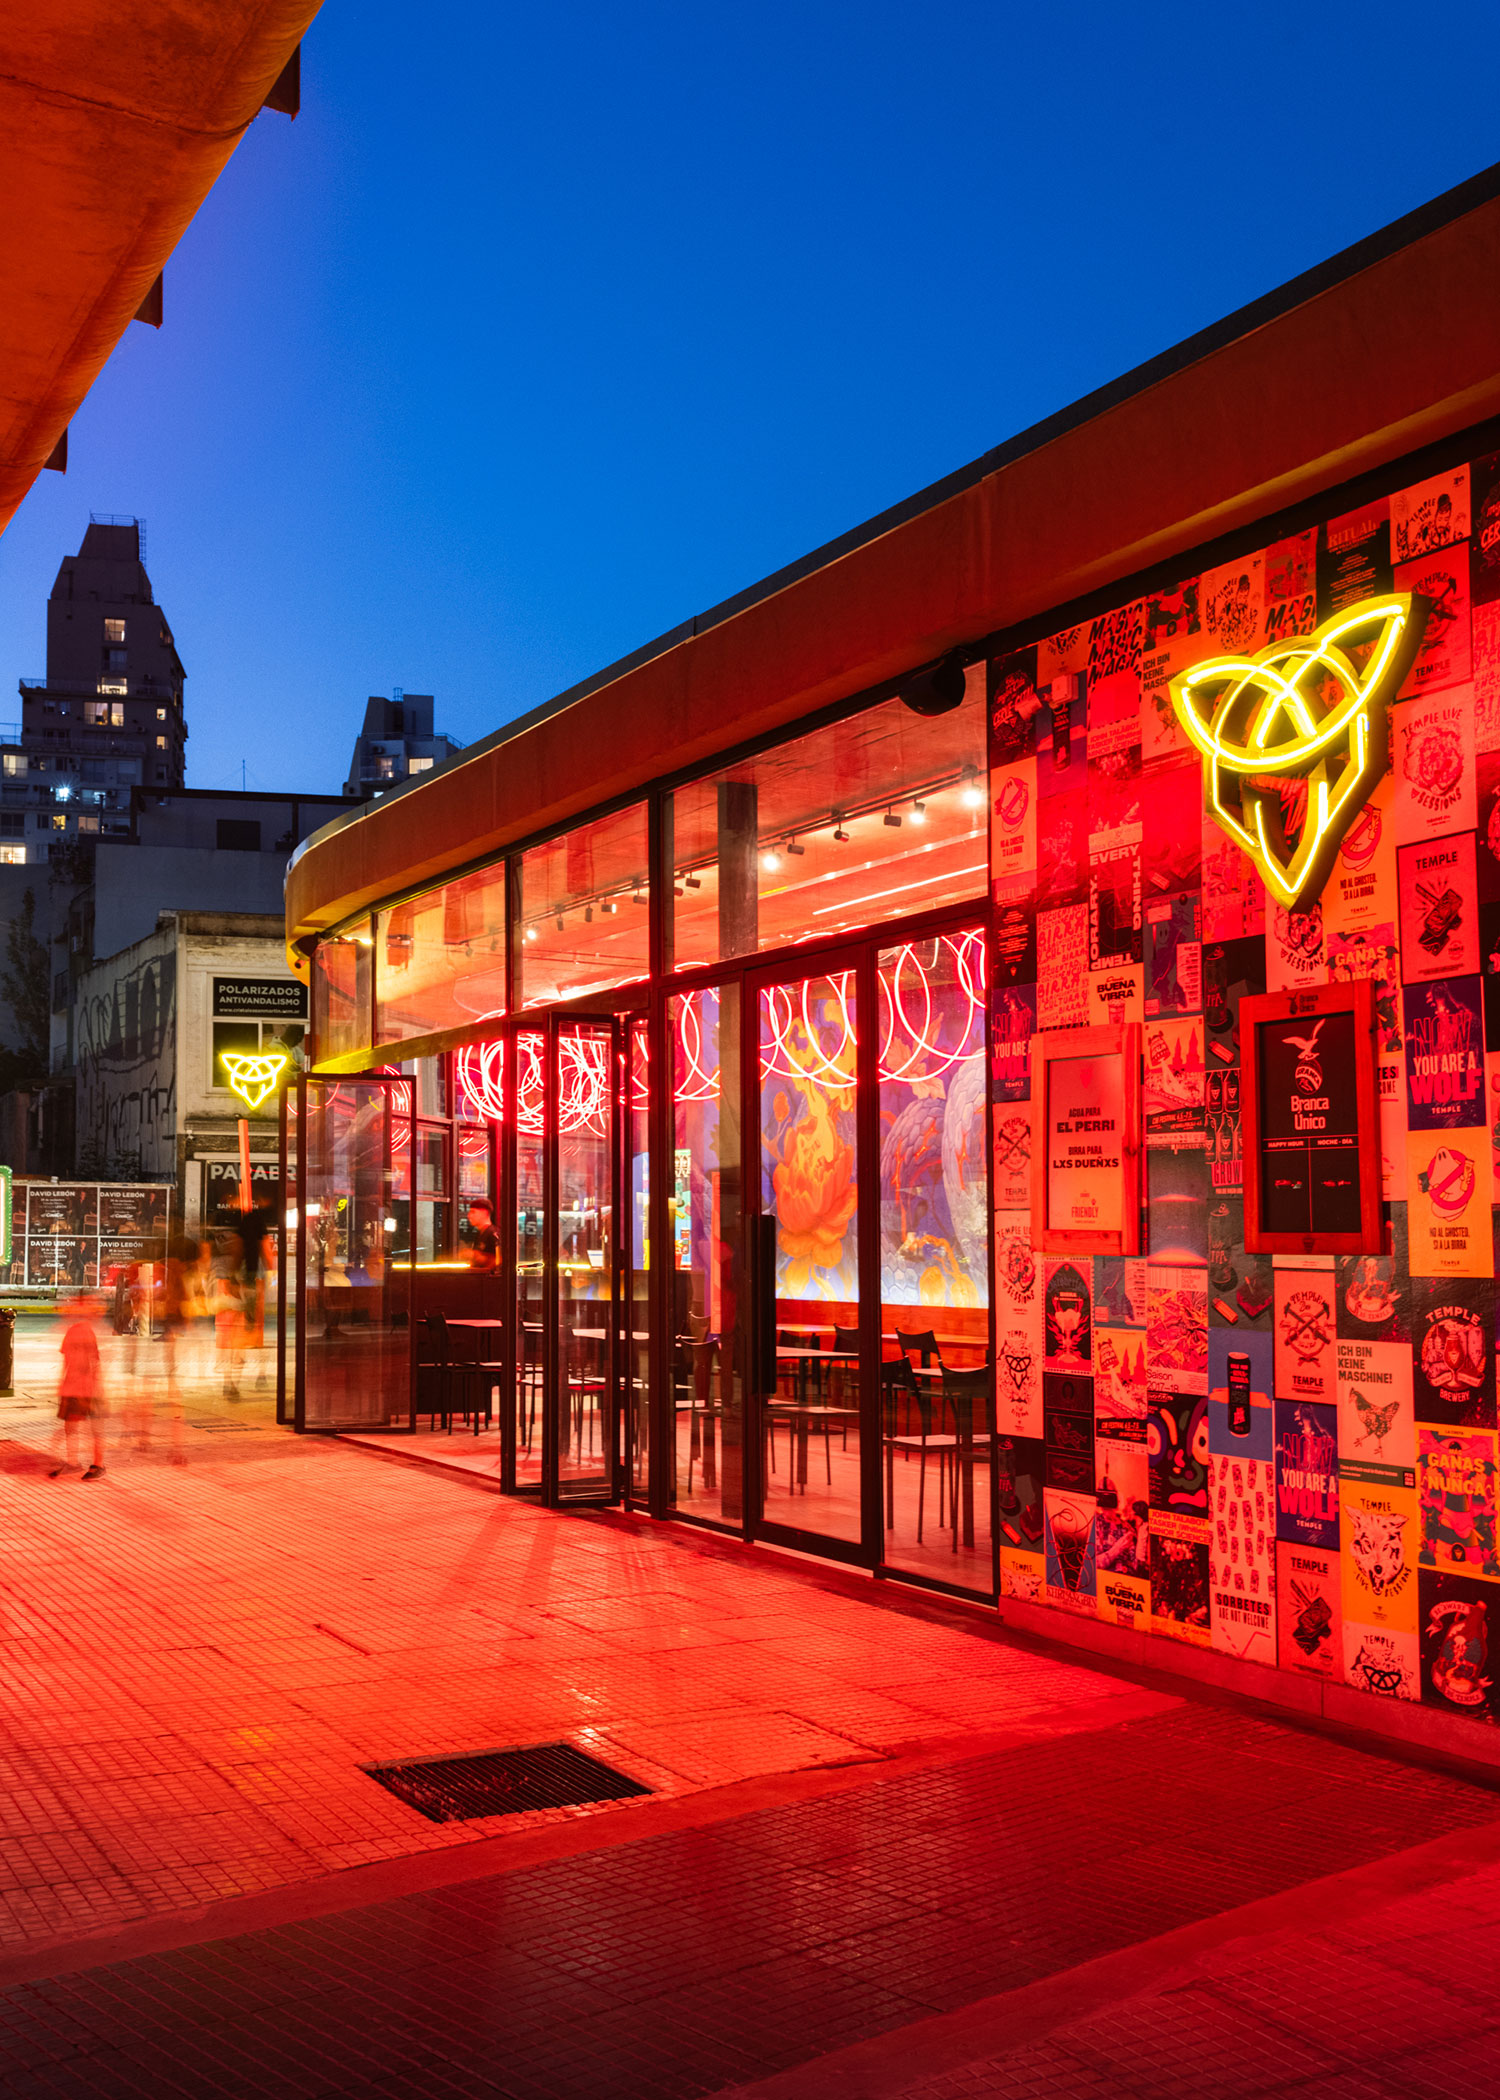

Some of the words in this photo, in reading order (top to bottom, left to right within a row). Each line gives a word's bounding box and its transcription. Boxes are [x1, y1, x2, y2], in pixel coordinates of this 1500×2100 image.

[1143, 658, 1156, 671] ICH
[1157, 652, 1171, 666] BIN
[1415, 659, 1451, 678] TEMPLE
[1143, 666, 1165, 682] KEINE
[1401, 713, 1440, 738] TEMPLE
[1443, 707, 1464, 721] LIVE
[1418, 787, 1462, 812] SESSIONS
[1090, 844, 1140, 867] EVERY
[1415, 851, 1458, 870] TEMPLE
[1132, 855, 1142, 931] THING
[1287, 951, 1325, 972] SESSIONS
[1335, 946, 1388, 965] GANAS
[219, 985, 300, 996] POLARIZADOS
[1097, 979, 1136, 994] BUENA
[219, 996, 300, 1006] ANTIVANDALISMO
[1099, 990, 1134, 1002] VIBRA
[994, 1042, 1011, 1059] YOU
[1012, 1040, 1026, 1056] ARE
[1413, 1055, 1440, 1077] YOU
[1441, 1053, 1466, 1073] ARE
[1467, 1051, 1476, 1070] A
[1409, 1068, 1483, 1105] WOLF
[1290, 1095, 1330, 1112] Branca
[1432, 1105, 1461, 1115] TEMPLE
[1069, 1108, 1084, 1118] AGUA
[1085, 1107, 1101, 1117] PARA
[1294, 1109, 1326, 1131] Único
[1056, 1123, 1073, 1134] EL
[1075, 1120, 1115, 1133] PERRI
[1288, 1140, 1304, 1148] HOUR
[1317, 1138, 1338, 1146] NOCHE
[1068, 1146, 1085, 1156] BIRRA
[1087, 1145, 1103, 1155] PARA
[1053, 1159, 1073, 1169] LXS
[1075, 1155, 1119, 1169] DUEÑXS
[52, 1190, 76, 1198] LEBÓN
[1005, 1187, 1028, 1196] TEMPLE
[1071, 1206, 1099, 1219] FRIENDLY
[53, 1239, 76, 1247] LEBÓN
[1007, 1286, 1035, 1305] SESSIONS
[1290, 1290, 1325, 1305] TEMPLE
[1425, 1305, 1481, 1327] TEMPLE
[1338, 1345, 1354, 1356] ICH
[1356, 1347, 1372, 1358] BIN
[1338, 1358, 1365, 1370] KEINE
[1292, 1375, 1324, 1387] TEMPLE
[1339, 1370, 1393, 1384] MASCHINE!
[1440, 1388, 1471, 1402] BREWERY
[1428, 1453, 1487, 1473] GANAS
[1282, 1471, 1305, 1490] YOU
[1307, 1475, 1327, 1494] ARE
[1328, 1477, 1337, 1495] A
[1428, 1476, 1486, 1497] NUNCA
[1278, 1483, 1339, 1522] WOLF
[1360, 1498, 1392, 1511] TEMPLE
[1296, 1519, 1323, 1531] TEMPLE
[1011, 1560, 1033, 1573] TEMPLE
[1291, 1556, 1329, 1574] TEMPLE
[1355, 1573, 1369, 1591] LIVE
[1384, 1566, 1412, 1598] SESSIONS
[1105, 1586, 1146, 1603] BUENA
[1107, 1596, 1144, 1613] VIBRA
[1215, 1592, 1270, 1615] SORBETES
[1218, 1606, 1229, 1620] ARE
[1230, 1609, 1241, 1623] NOT
[1243, 1613, 1269, 1630] WELCOME
[1364, 1634, 1395, 1650] TEMPLE
